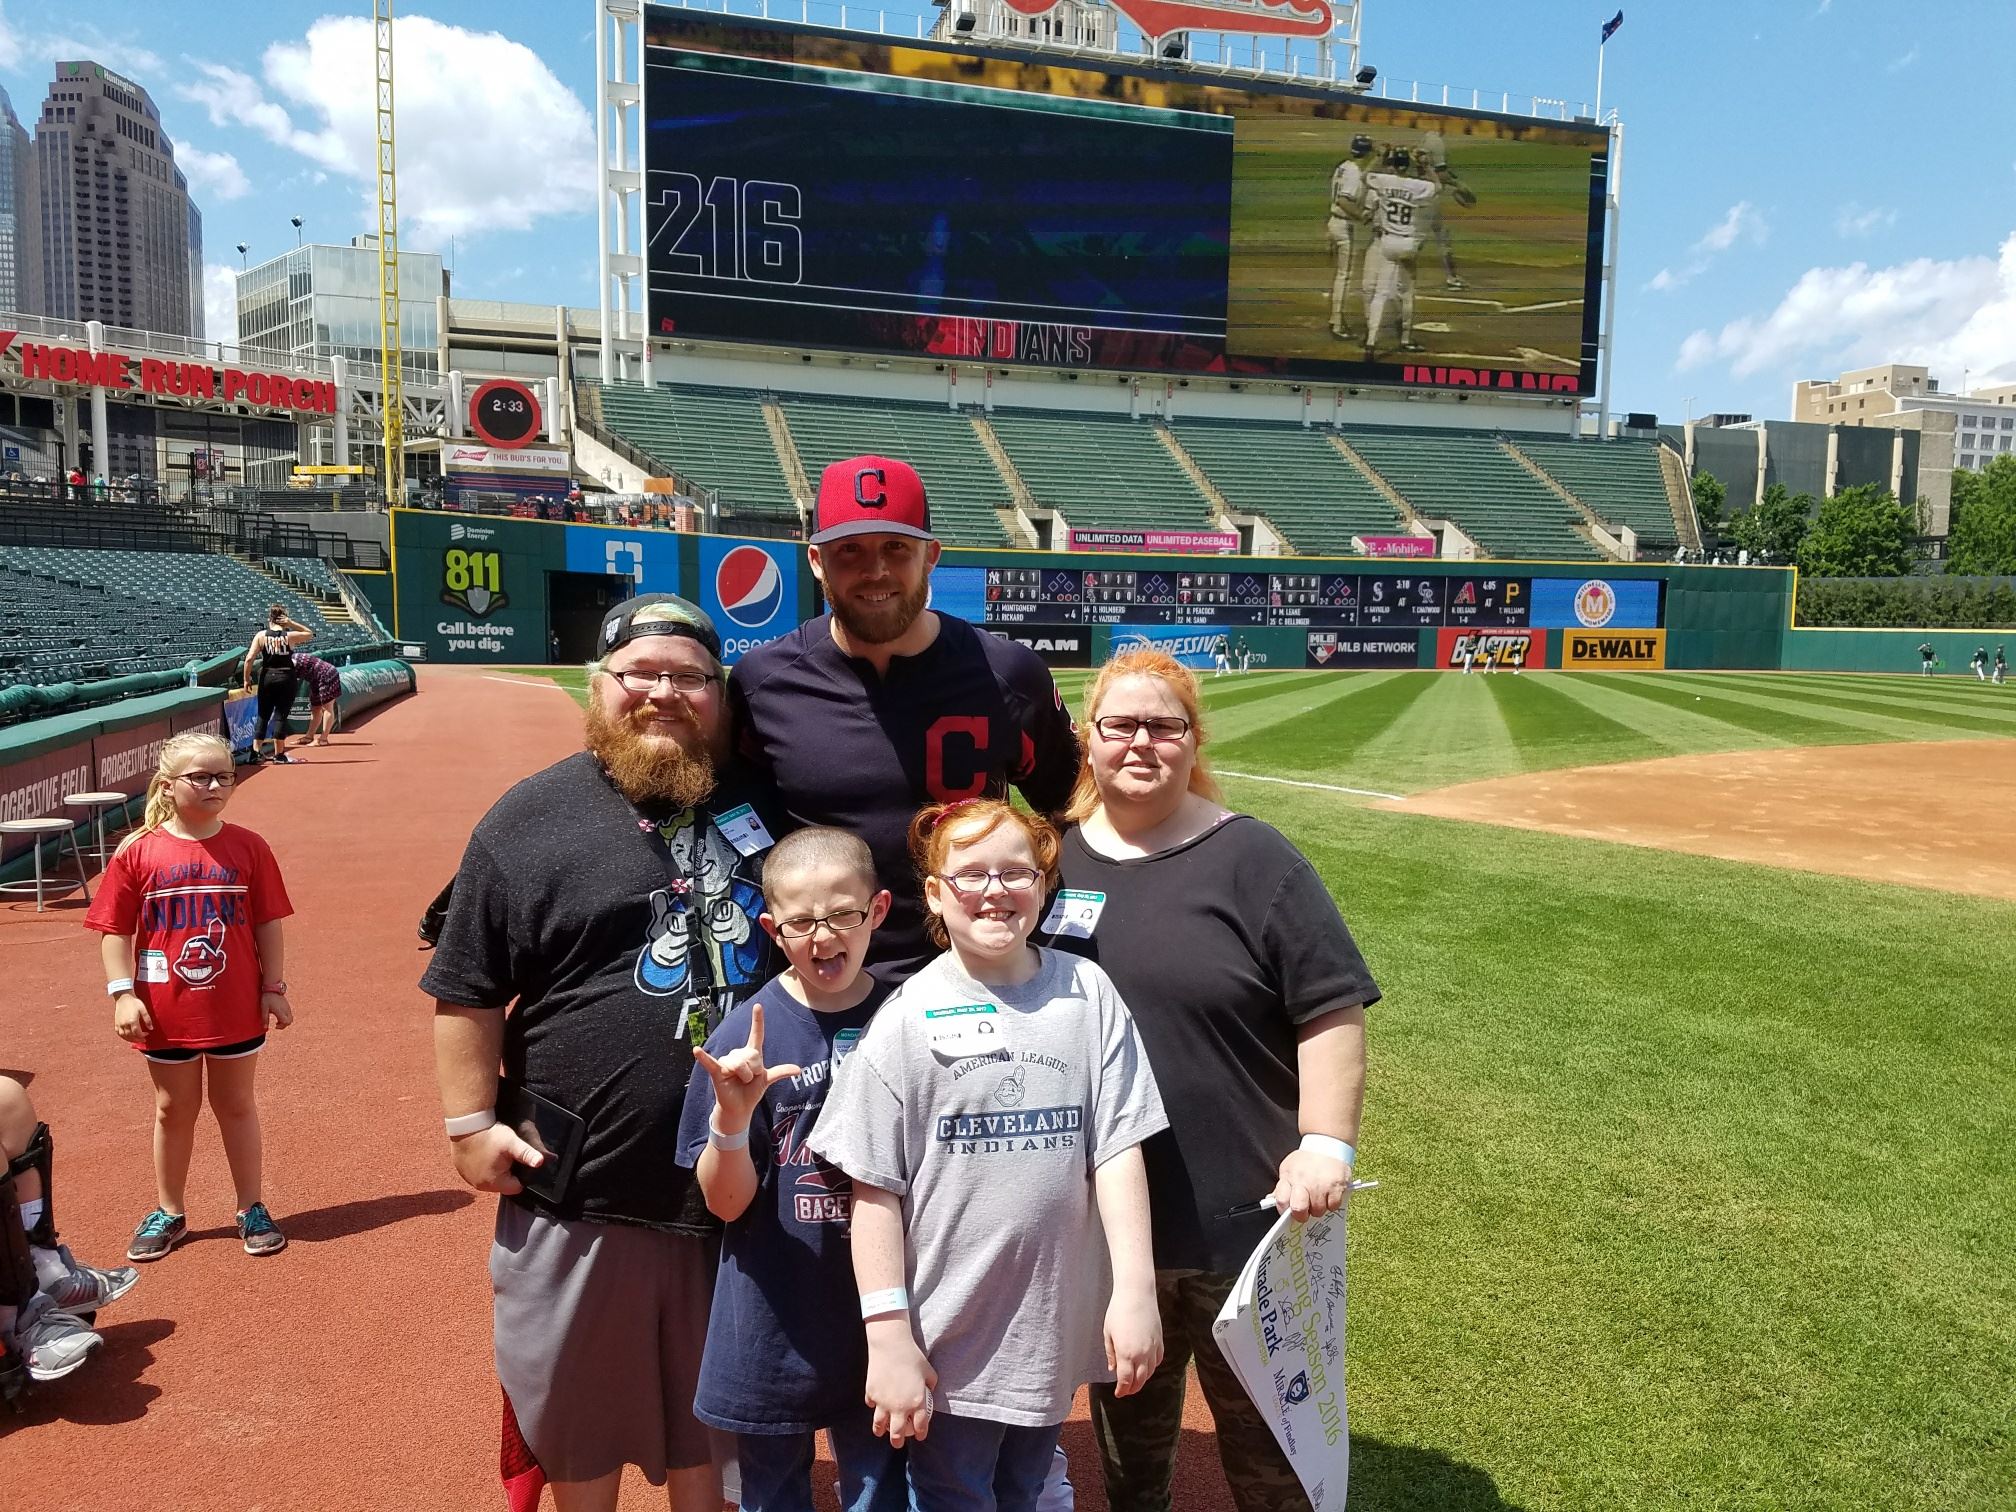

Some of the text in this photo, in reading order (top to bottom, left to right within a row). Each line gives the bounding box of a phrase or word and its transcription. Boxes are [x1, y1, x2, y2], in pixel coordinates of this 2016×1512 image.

[103, 70, 136, 94] Huntington
[1387, 203, 1411, 226] 28
[648, 169, 801, 286] 216
[955, 317, 1092, 364] INDIANS
[22, 342, 336, 414] HOME RUN PORCH
[493, 399, 524, 413] 2:33
[493, 453, 509, 461] THIS
[533, 456, 547, 464] FOR
[548, 457, 564, 465] YOU.
[854, 469, 886, 506] C
[467, 526, 495, 535] Dominion
[467, 533, 488, 541] Energy
[1075, 533, 1234, 546] UNLIMITED DATA UNLIMITED BASEBALL
[446, 549, 500, 593] 811
[1398, 598, 1406, 607] AT
[1454, 581, 1476, 604] A
[1485, 599, 1492, 608] AT
[1506, 583, 1520, 604] P
[1586, 595, 1604, 613] M
[437, 622, 514, 636] Call before
[1309, 634, 1335, 643] MLB
[264, 643, 289, 655] WILL
[448, 637, 505, 653] you dig.
[724, 636, 777, 658] pep
[1014, 639, 1079, 651] RAM
[1114, 634, 1228, 659] PROGRESSIV
[1337, 642, 1362, 652] MLB
[1363, 642, 1416, 653] NETWORK
[1450, 635, 1530, 664] BASTER
[1249, 653, 1267, 663] 370
[100, 739, 165, 789] PROGRESSIVE FIEL
[926, 715, 989, 802] C
[61, 765, 87, 806] FIELD
[151, 864, 239, 889] CLEVELAND
[143, 894, 248, 933] INDIANS
[954, 1052, 1068, 1081] AMERICAN LEAGUE
[776, 1102, 823, 1116] Cooperstown
[939, 1110, 1078, 1138] CLEVELAND
[948, 1135, 1074, 1155] INDIANS
[1261, 1310, 1284, 1358] Park
[1303, 1312, 1329, 1395] Season
[1318, 1392, 1345, 1447] 2016
[1283, 1425, 1298, 1456] Findlay
